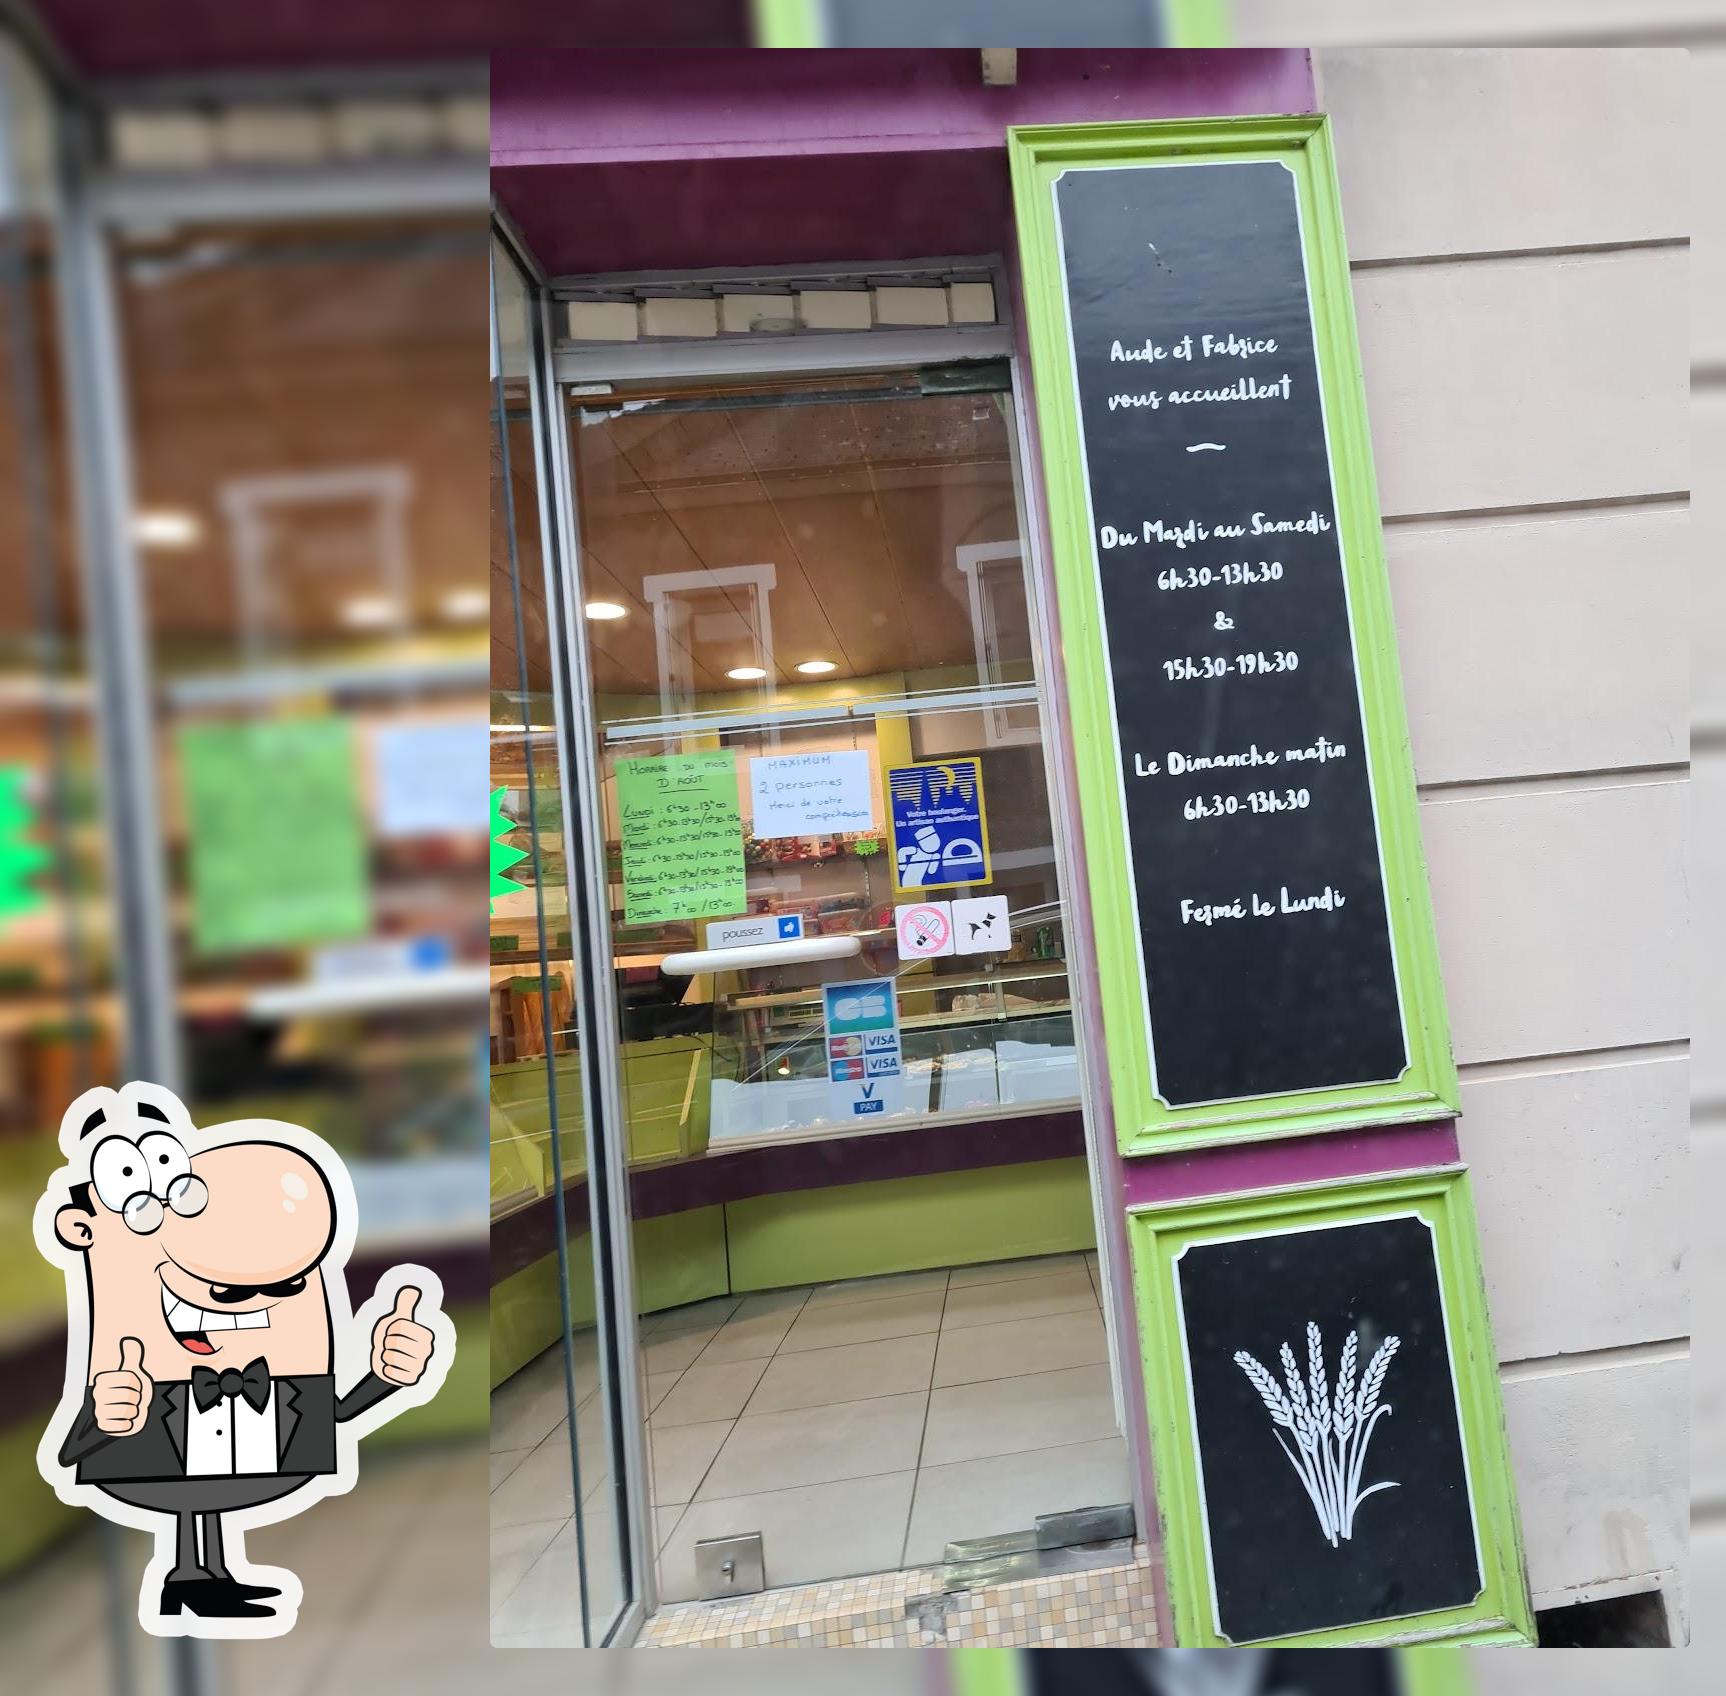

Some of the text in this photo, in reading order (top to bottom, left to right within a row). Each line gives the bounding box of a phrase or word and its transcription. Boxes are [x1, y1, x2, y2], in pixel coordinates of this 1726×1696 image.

[1110, 334, 1278, 363] Aude et Fabrice
[1108, 374, 1292, 411] vous accueillent
[1101, 511, 1331, 549] Du Mardi au Samedi
[1157, 561, 1283, 590] 6h30-13h30
[1213, 610, 1235, 630] &
[1162, 651, 1298, 680] 15h30-19h30
[768, 755, 831, 770] MAXIMUM
[1135, 736, 1346, 777] Le Dimanche matin
[759, 781, 769, 794] 2
[1183, 788, 1311, 821] 6h30-13h30
[1180, 885, 1346, 926] Fermé le Lundi
[722, 926, 764, 941] poussez
[869, 1034, 897, 1046] VISA
[871, 1058, 898, 1070] VISA
[859, 1082, 875, 1099] V
[860, 1102, 878, 1111] PAY
